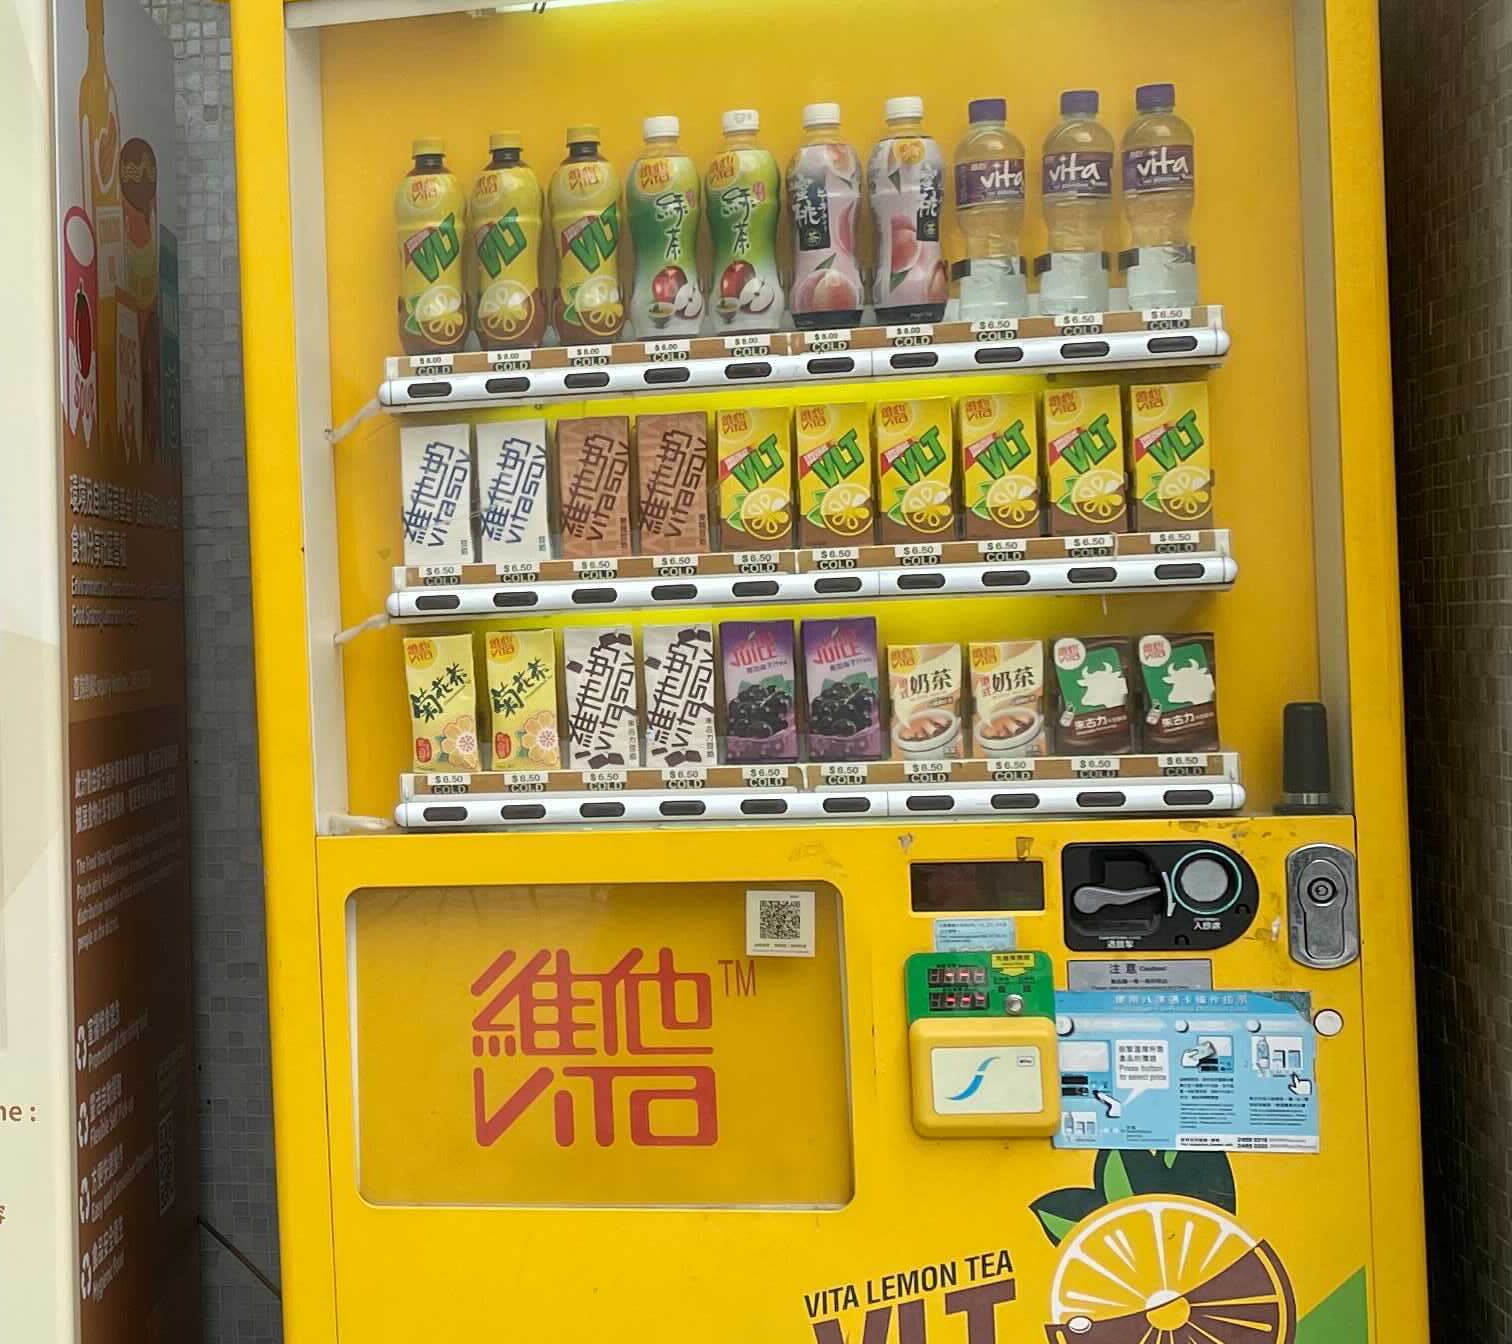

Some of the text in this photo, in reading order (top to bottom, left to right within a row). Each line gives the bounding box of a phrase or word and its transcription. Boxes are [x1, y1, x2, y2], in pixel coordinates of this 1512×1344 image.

[730, 433, 785, 493] VLT
[810, 427, 866, 489] VLT
[891, 425, 948, 487] VLT
[976, 418, 1031, 480] VLT
[1060, 413, 1118, 475] VLT
[1143, 409, 1205, 472] VLT
[410, 663, 468, 724] 菊花茶
[491, 658, 552, 719] 菊花茶
[471, 946, 714, 1056] 維他
[718, 959, 757, 997] TM
[803, 1249, 1014, 1319] VITA LEMON TEA
